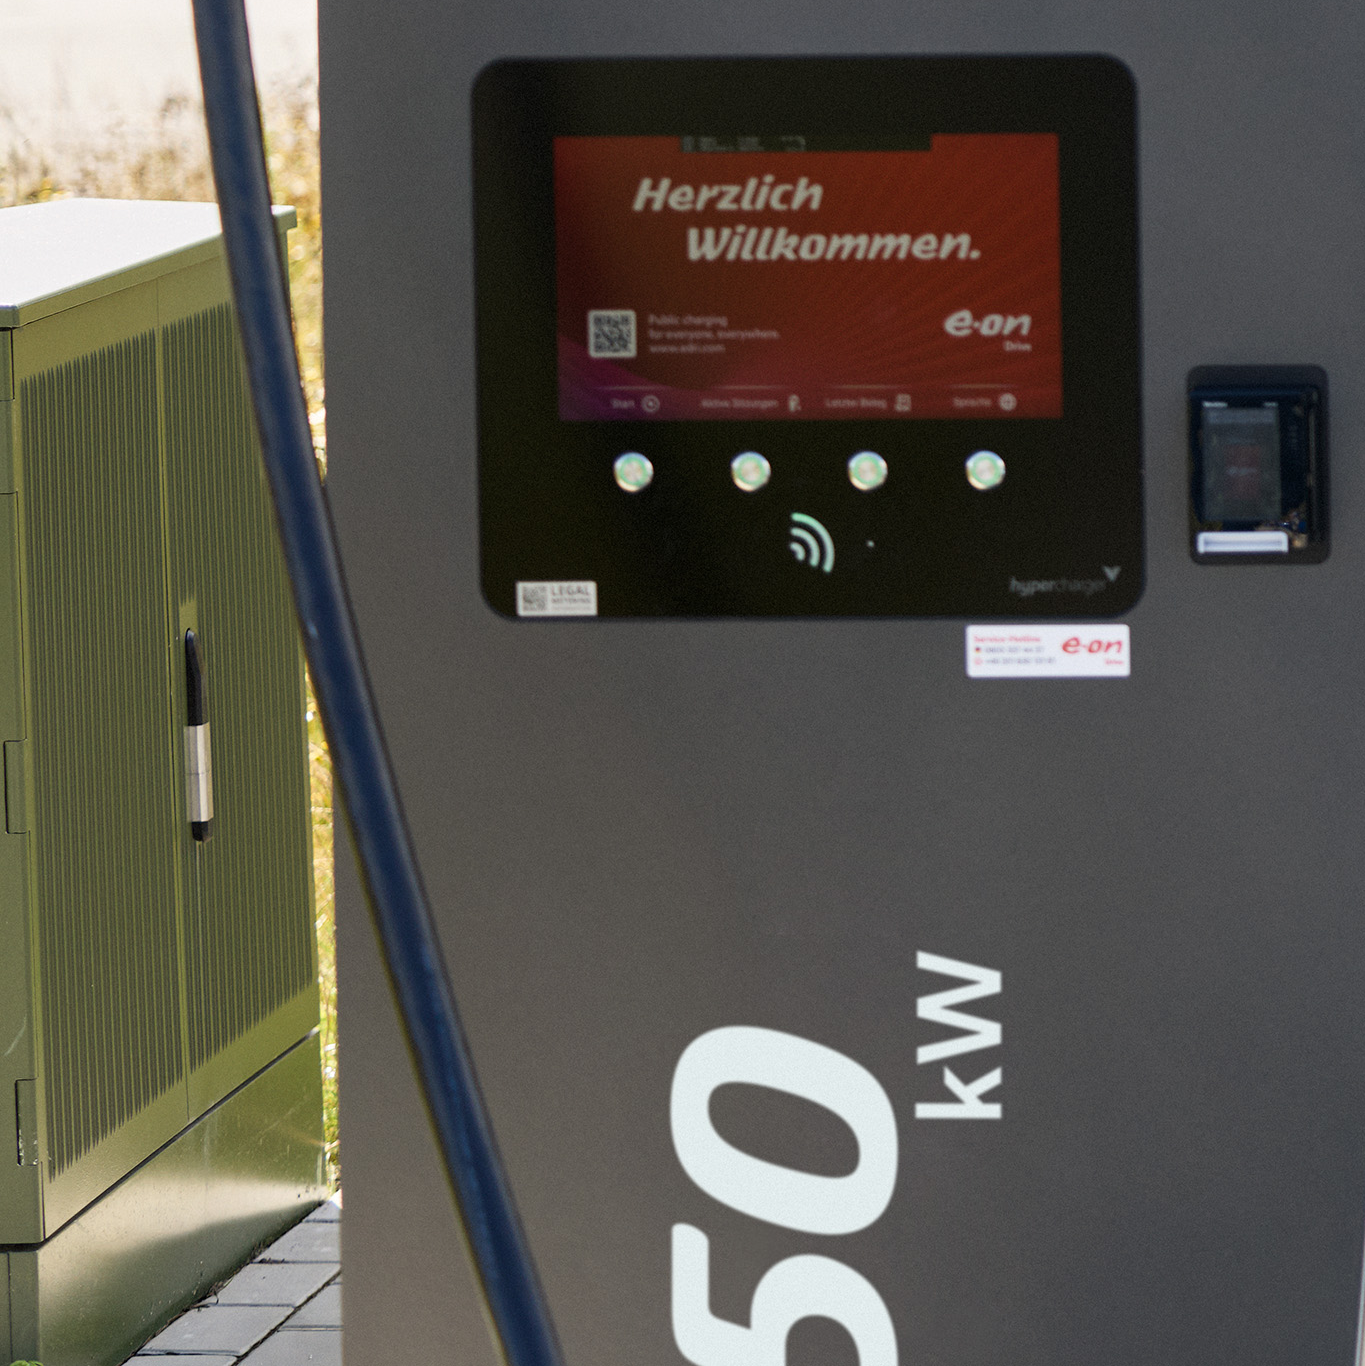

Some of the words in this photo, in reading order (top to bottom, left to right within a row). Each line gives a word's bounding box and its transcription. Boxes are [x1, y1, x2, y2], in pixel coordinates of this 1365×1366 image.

[633, 175, 824, 212] Herzlich
[686, 225, 982, 263] Willkommen.
[551, 585, 591, 597] LEGAL
[914, 950, 1003, 1120] kW
